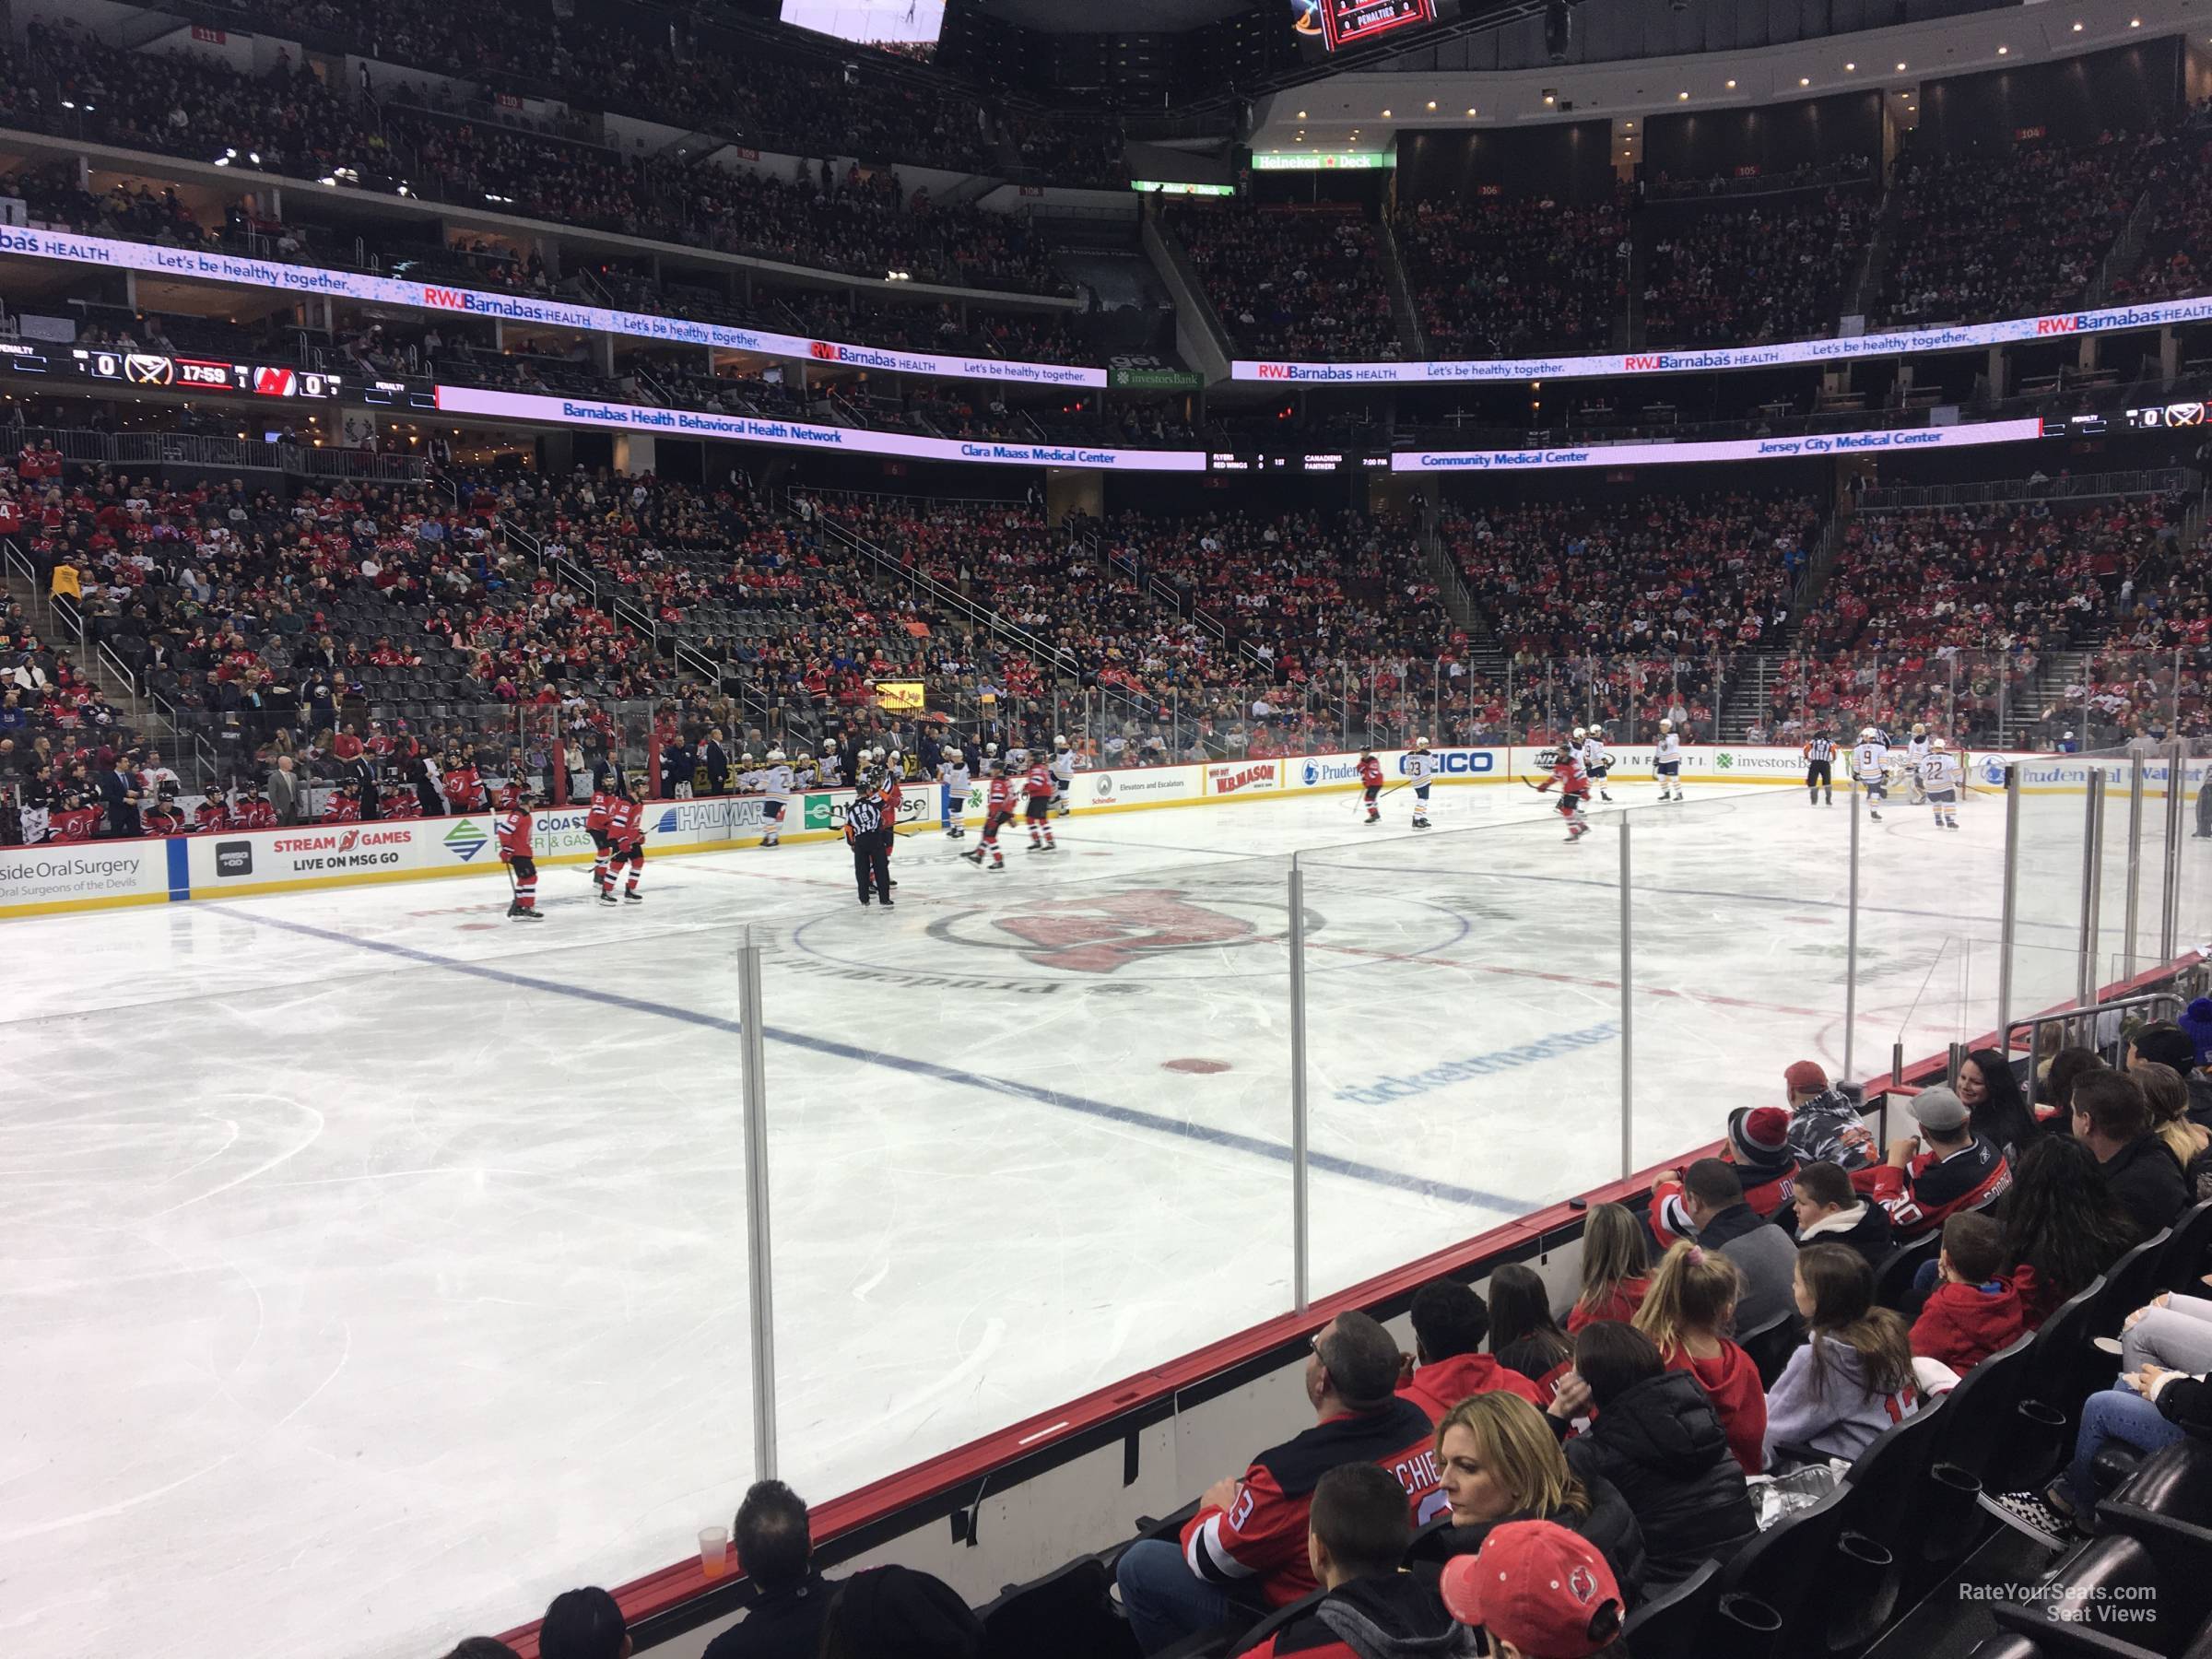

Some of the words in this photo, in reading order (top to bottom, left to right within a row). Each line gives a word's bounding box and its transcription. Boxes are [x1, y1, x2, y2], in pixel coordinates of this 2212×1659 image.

[1357, 6, 1395, 26] PENALTIES
[199, 29, 218, 41] 111
[1260, 156, 1320, 169] Heineken
[1340, 156, 1371, 167] Deck
[1197, 185, 1218, 194] Deck
[46, 241, 110, 262] HEALTH
[158, 252, 194, 271] Let's
[199, 256, 218, 273] be
[224, 261, 278, 285] healthy
[284, 271, 351, 291] together.
[546, 310, 591, 327] HEALTH
[624, 317, 650, 333] Let's
[653, 320, 667, 335] be
[670, 324, 709, 342] healthy
[712, 331, 760, 347] together.
[1813, 342, 1841, 356] Let's
[1844, 340, 1859, 354] be
[1863, 335, 1909, 353] healthy
[1912, 331, 1968, 350] together.
[98, 356, 115, 375] 0
[899, 359, 936, 371] HEALTH
[1735, 352, 1779, 365] HEALTH
[182, 365, 226, 383] 17:59
[964, 362, 987, 374] Let's
[990, 364, 1003, 375] be
[1005, 366, 1040, 381] healthy
[1042, 370, 1086, 384] together.
[1131, 372, 1198, 384] investorsBank
[1356, 370, 1397, 379] HEALTH
[1428, 365, 1452, 376] Let's
[1455, 365, 1468, 375] be
[1471, 364, 1512, 377] healthy
[1514, 363, 1565, 376] together.
[238, 376, 246, 388] 1
[306, 375, 321, 394] 0
[375, 381, 406, 392] PENALTY
[563, 403, 629, 422] Barnabas
[631, 407, 676, 427] Health
[679, 412, 745, 433] Behavioral
[747, 419, 787, 437] Health
[791, 426, 842, 443] Network
[2072, 415, 2099, 423] PENALTY
[2145, 411, 2158, 426] 0
[1758, 442, 1801, 453] Jersey
[1805, 439, 1832, 452] City
[1836, 433, 1888, 448] Medical
[1894, 432, 1944, 444] Center
[961, 444, 991, 457] Clara
[994, 446, 1030, 459] Maass
[1032, 449, 1076, 462] Medical
[1078, 451, 1116, 464] Center
[1258, 453, 1264, 462] 0
[1421, 454, 1491, 468] Community
[1494, 453, 1542, 465] Medical
[1546, 452, 1590, 463] Center
[1258, 462, 1264, 470] 0
[1534, 750, 1558, 762] NH
[1864, 750, 1872, 765] 9
[1322, 763, 1362, 781] Pruden
[1926, 761, 1944, 781] 22
[1120, 782, 1145, 792] Elevators
[1147, 782, 1156, 790] and
[1157, 779, 1184, 789] Escalators
[1091, 796, 1117, 805] Schindler
[677, 801, 766, 831] HALMAR
[857, 811, 870, 824] 19
[274, 837, 335, 853] STREAM
[361, 831, 412, 845] GAMES
[551, 834, 559, 848] &
[563, 833, 591, 845] GAS
[294, 858, 324, 871] LIVE
[327, 856, 347, 868] ON
[349, 853, 377, 866] MSG
[380, 852, 399, 864] GO
[0, 864, 34, 881] side
[37, 860, 72, 877] Oral
[74, 859, 140, 877] Surgery
[0, 887, 18, 898] Oral
[21, 885, 71, 896] Surgeons
[74, 881, 84, 891] of
[87, 879, 103, 890] the
[106, 877, 137, 888] Devils
